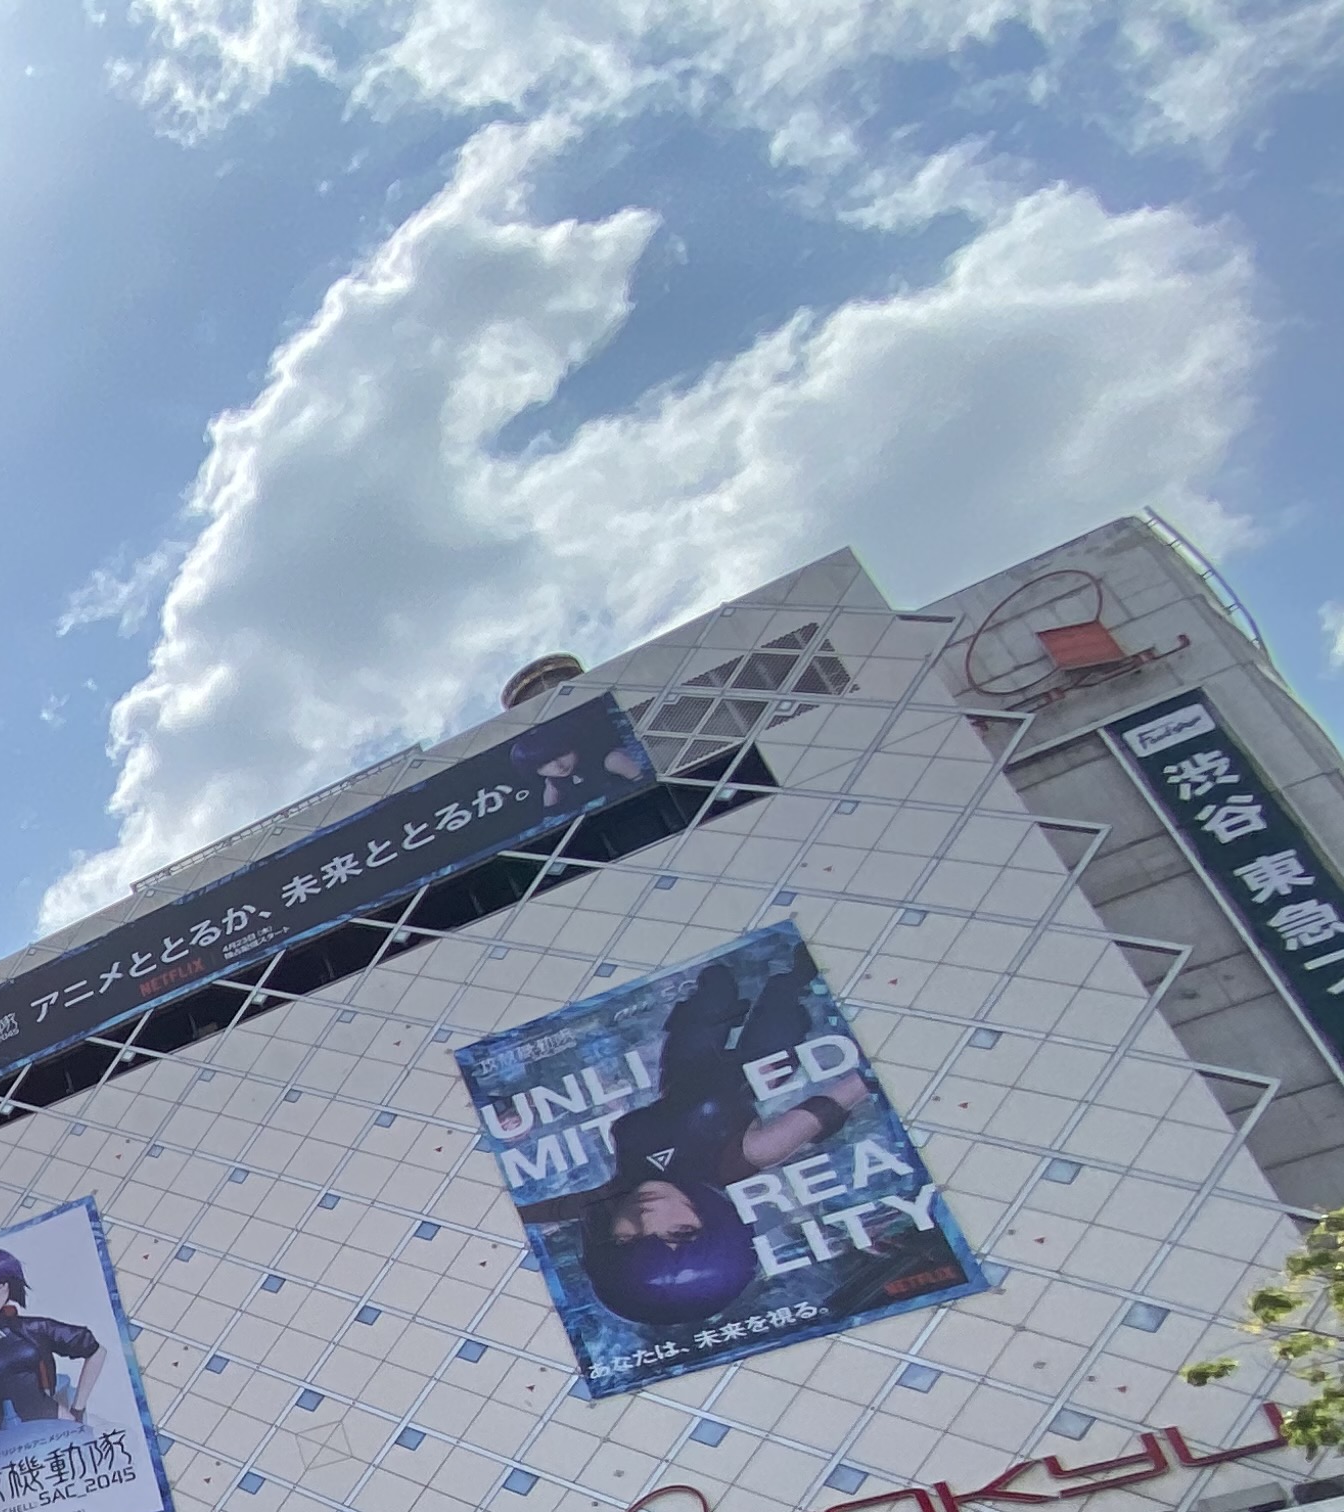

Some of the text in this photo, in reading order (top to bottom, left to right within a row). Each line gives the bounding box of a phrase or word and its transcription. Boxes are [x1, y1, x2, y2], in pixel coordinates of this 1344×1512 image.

[138, 958, 205, 997] NETFLIX
[483, 1052, 653, 1142] UNLI
[742, 1035, 861, 1103] ED
[725, 1139, 915, 1226] REA
[752, 1184, 941, 1277] LITY
